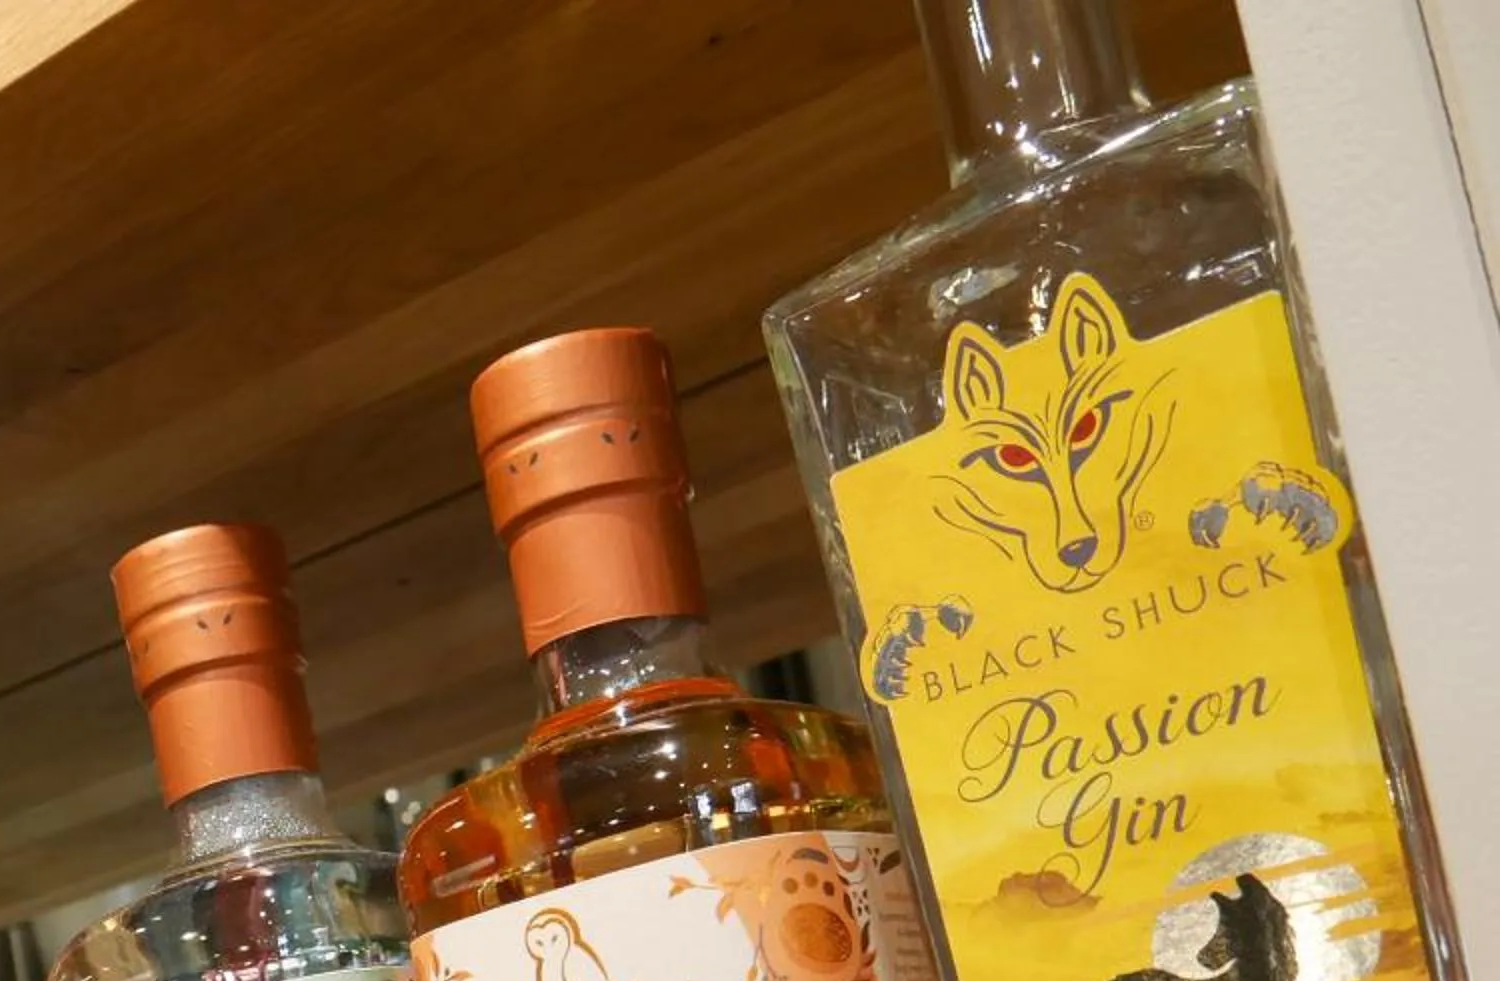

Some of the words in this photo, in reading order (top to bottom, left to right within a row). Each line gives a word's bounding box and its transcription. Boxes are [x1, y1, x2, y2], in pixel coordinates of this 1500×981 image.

[924, 626, 1075, 703] BLACK
[1102, 553, 1287, 641] SHUCK
[957, 675, 1283, 803] Passion
[1036, 771, 1198, 908] Gin
